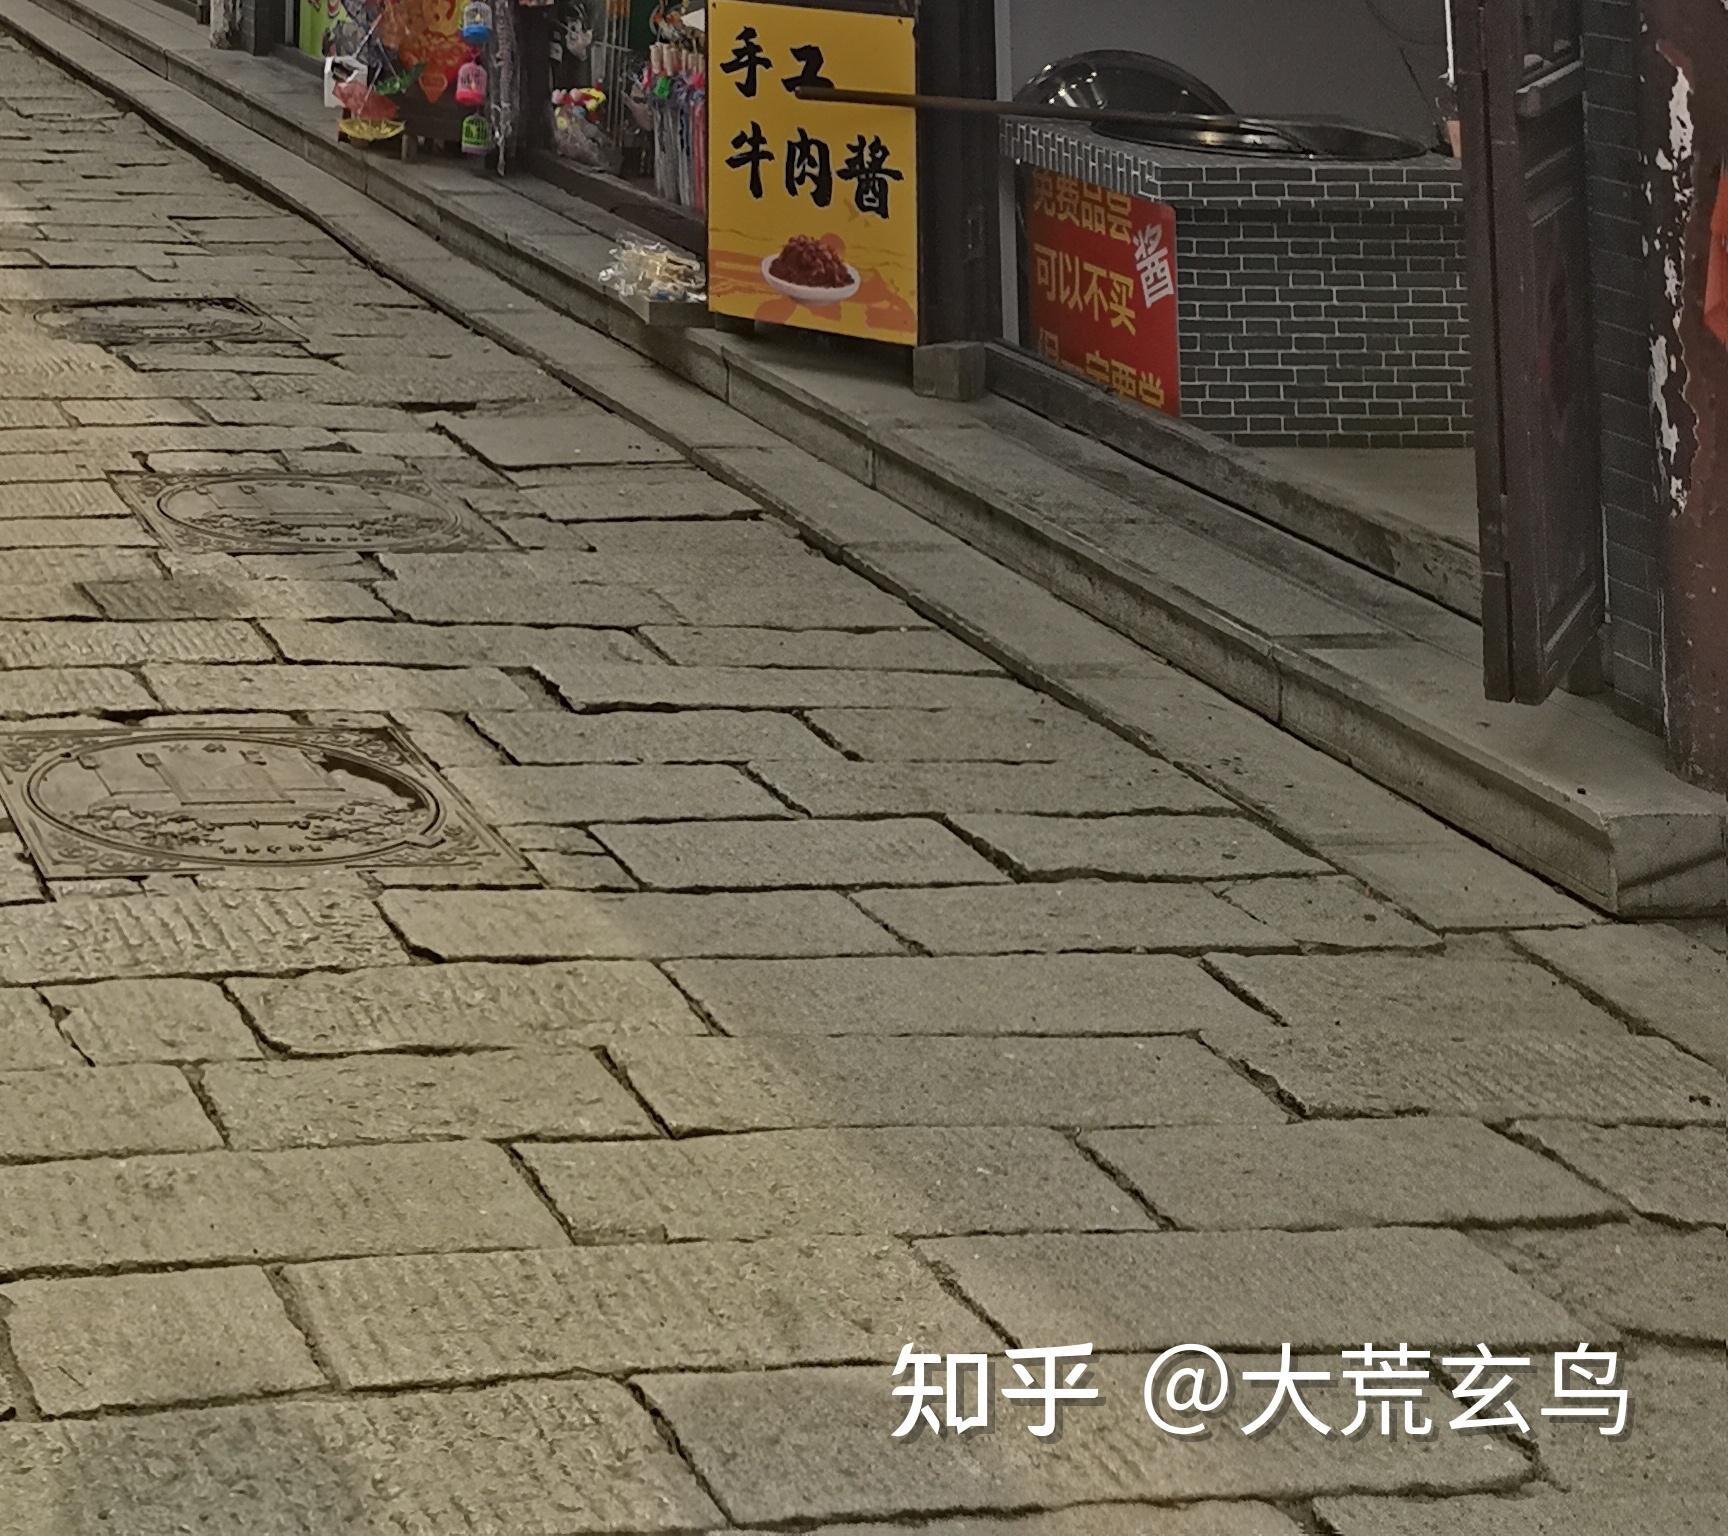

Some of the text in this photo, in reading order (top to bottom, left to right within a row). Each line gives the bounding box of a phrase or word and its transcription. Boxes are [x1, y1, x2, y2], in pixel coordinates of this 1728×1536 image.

[719, 25, 835, 98] 手工
[725, 120, 905, 220] 牛肉酱
[1033, 242, 1137, 337] 可以不买
[1132, 222, 1175, 309] 酱
